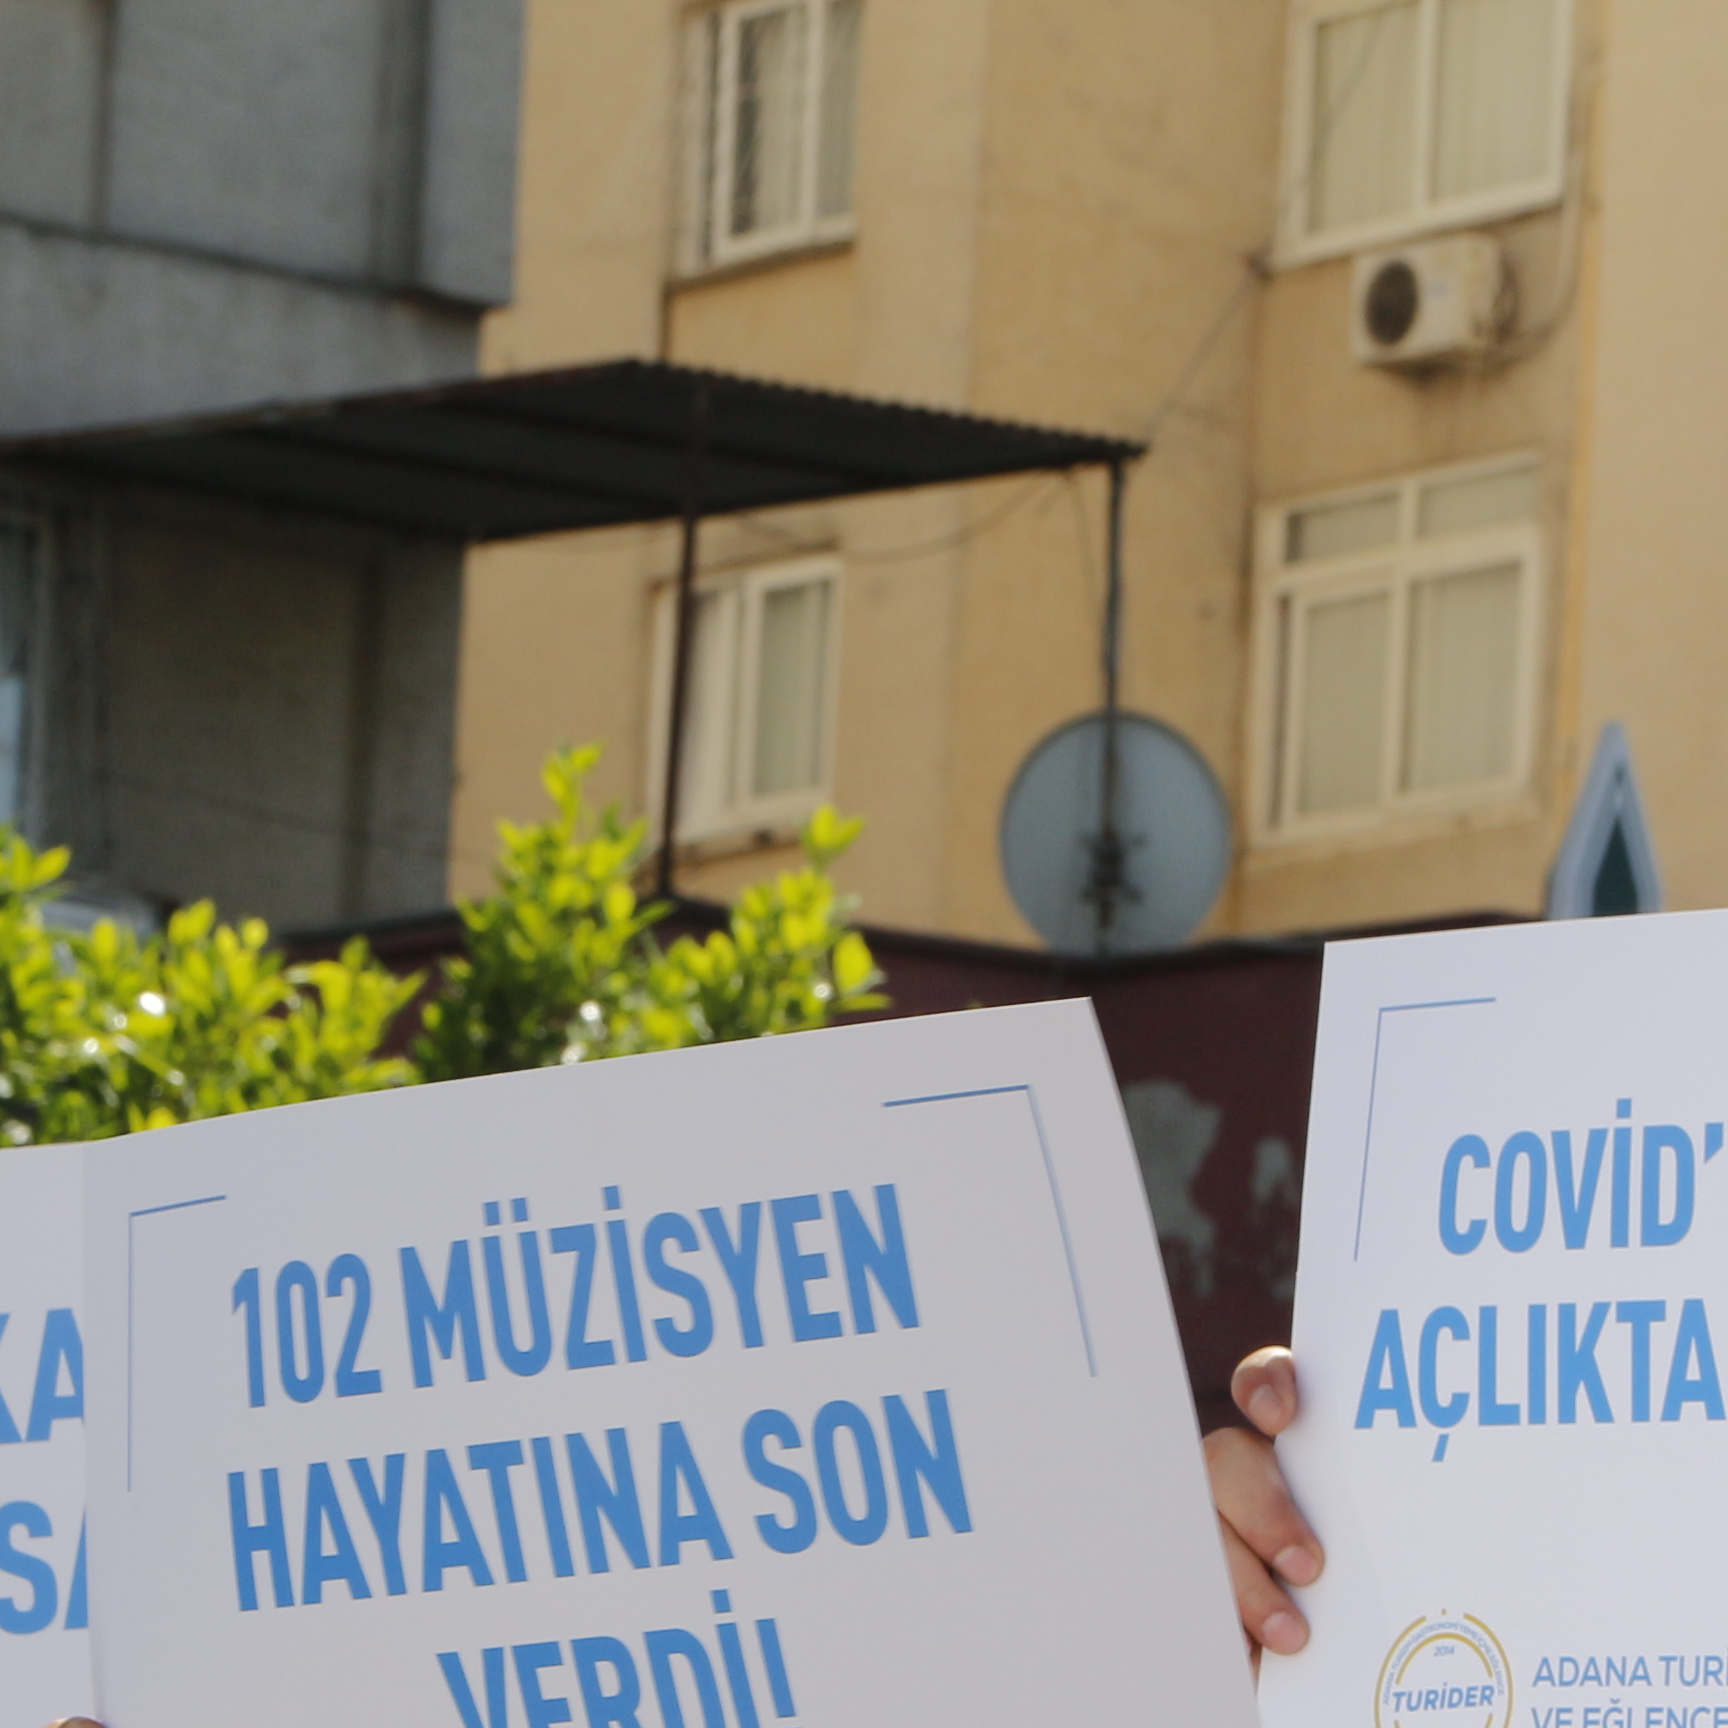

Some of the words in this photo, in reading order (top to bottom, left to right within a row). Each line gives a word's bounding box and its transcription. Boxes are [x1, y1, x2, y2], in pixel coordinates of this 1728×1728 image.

[234, 1254, 382, 1407] 102
[400, 1184, 919, 1387] MÜZİSYEN
[229, 1421, 733, 1610] HAYATINA
[743, 1389, 972, 1553] SON
[1392, 1681, 1495, 1712] TURİDER
[1531, 1655, 1652, 1687] ADANA
